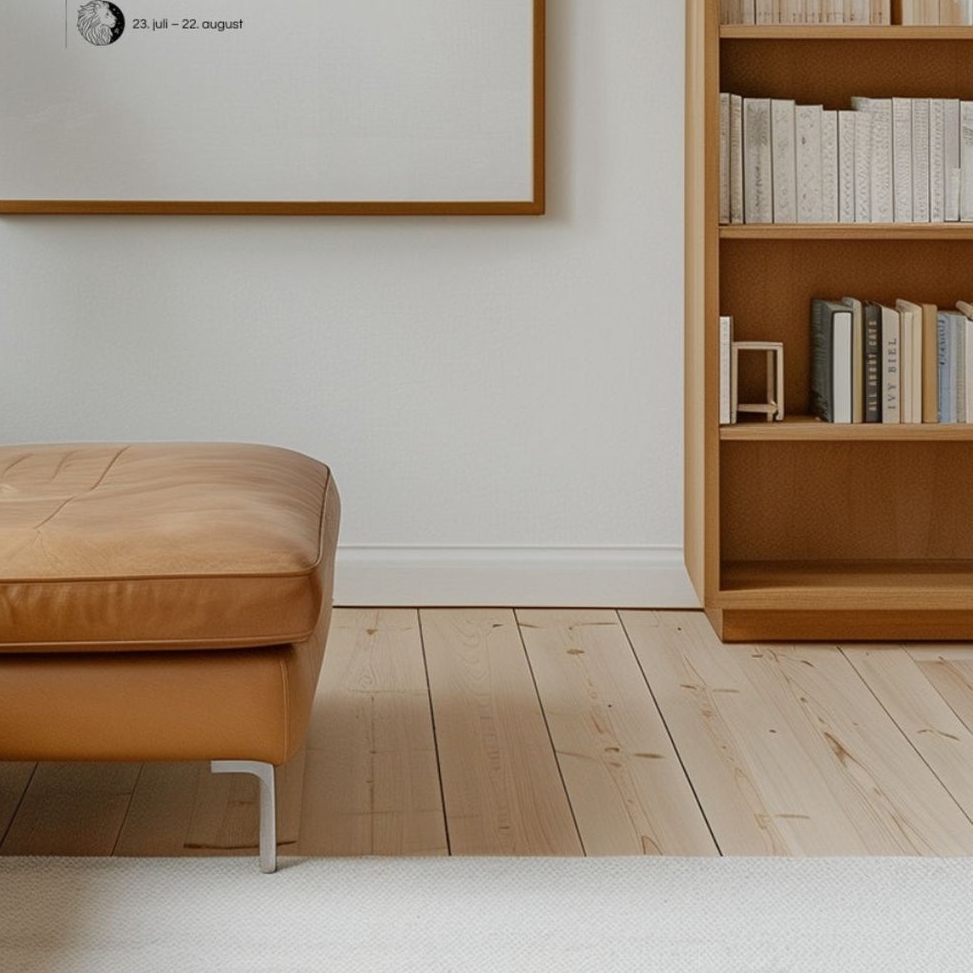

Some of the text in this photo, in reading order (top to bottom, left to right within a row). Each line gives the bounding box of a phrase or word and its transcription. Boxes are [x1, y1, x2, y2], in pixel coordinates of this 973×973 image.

[132, 18, 150, 30] 23.
[152, 18, 169, 32] juli
[181, 18, 200, 30] 22.
[201, 18, 244, 33] august
[887, 338, 897, 410] IVY BIEL
